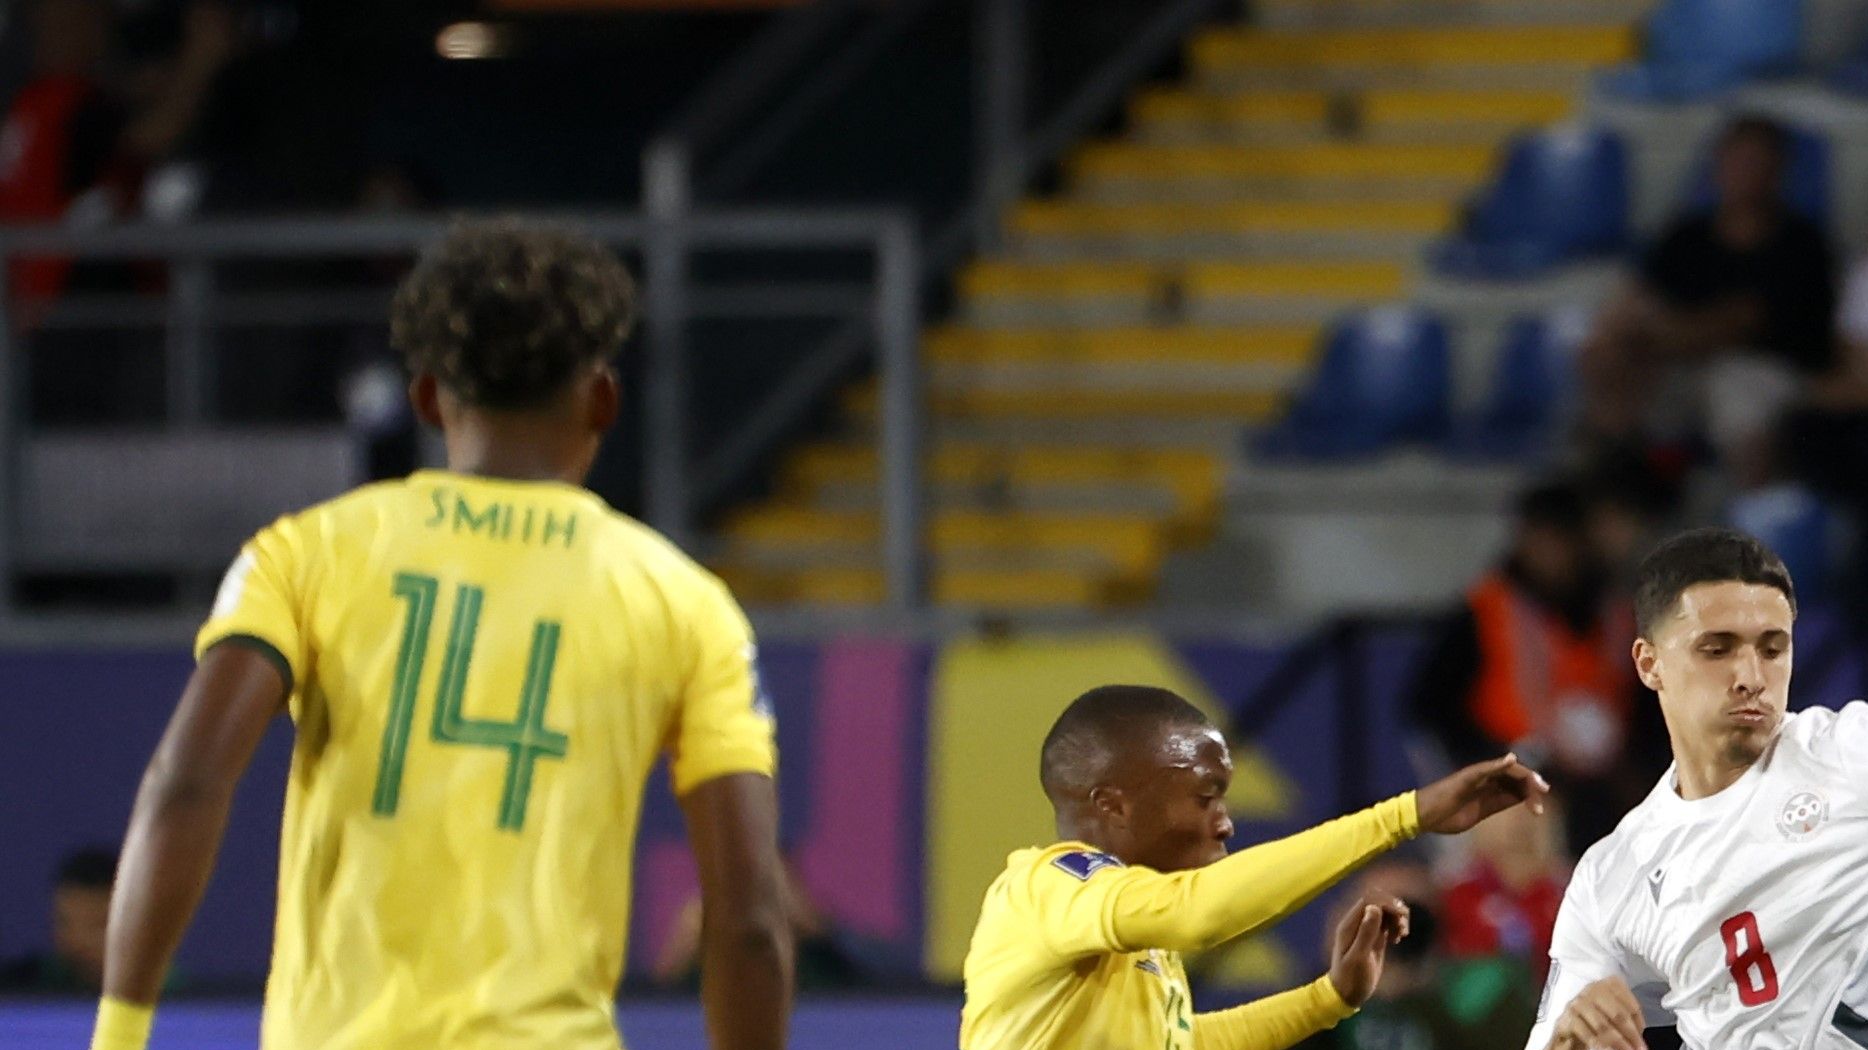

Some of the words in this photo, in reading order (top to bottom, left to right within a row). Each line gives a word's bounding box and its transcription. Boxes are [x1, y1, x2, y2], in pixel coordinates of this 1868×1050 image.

[425, 486, 577, 549] SMITH
[372, 570, 568, 832] 14
[1720, 910, 1779, 1007] 8
